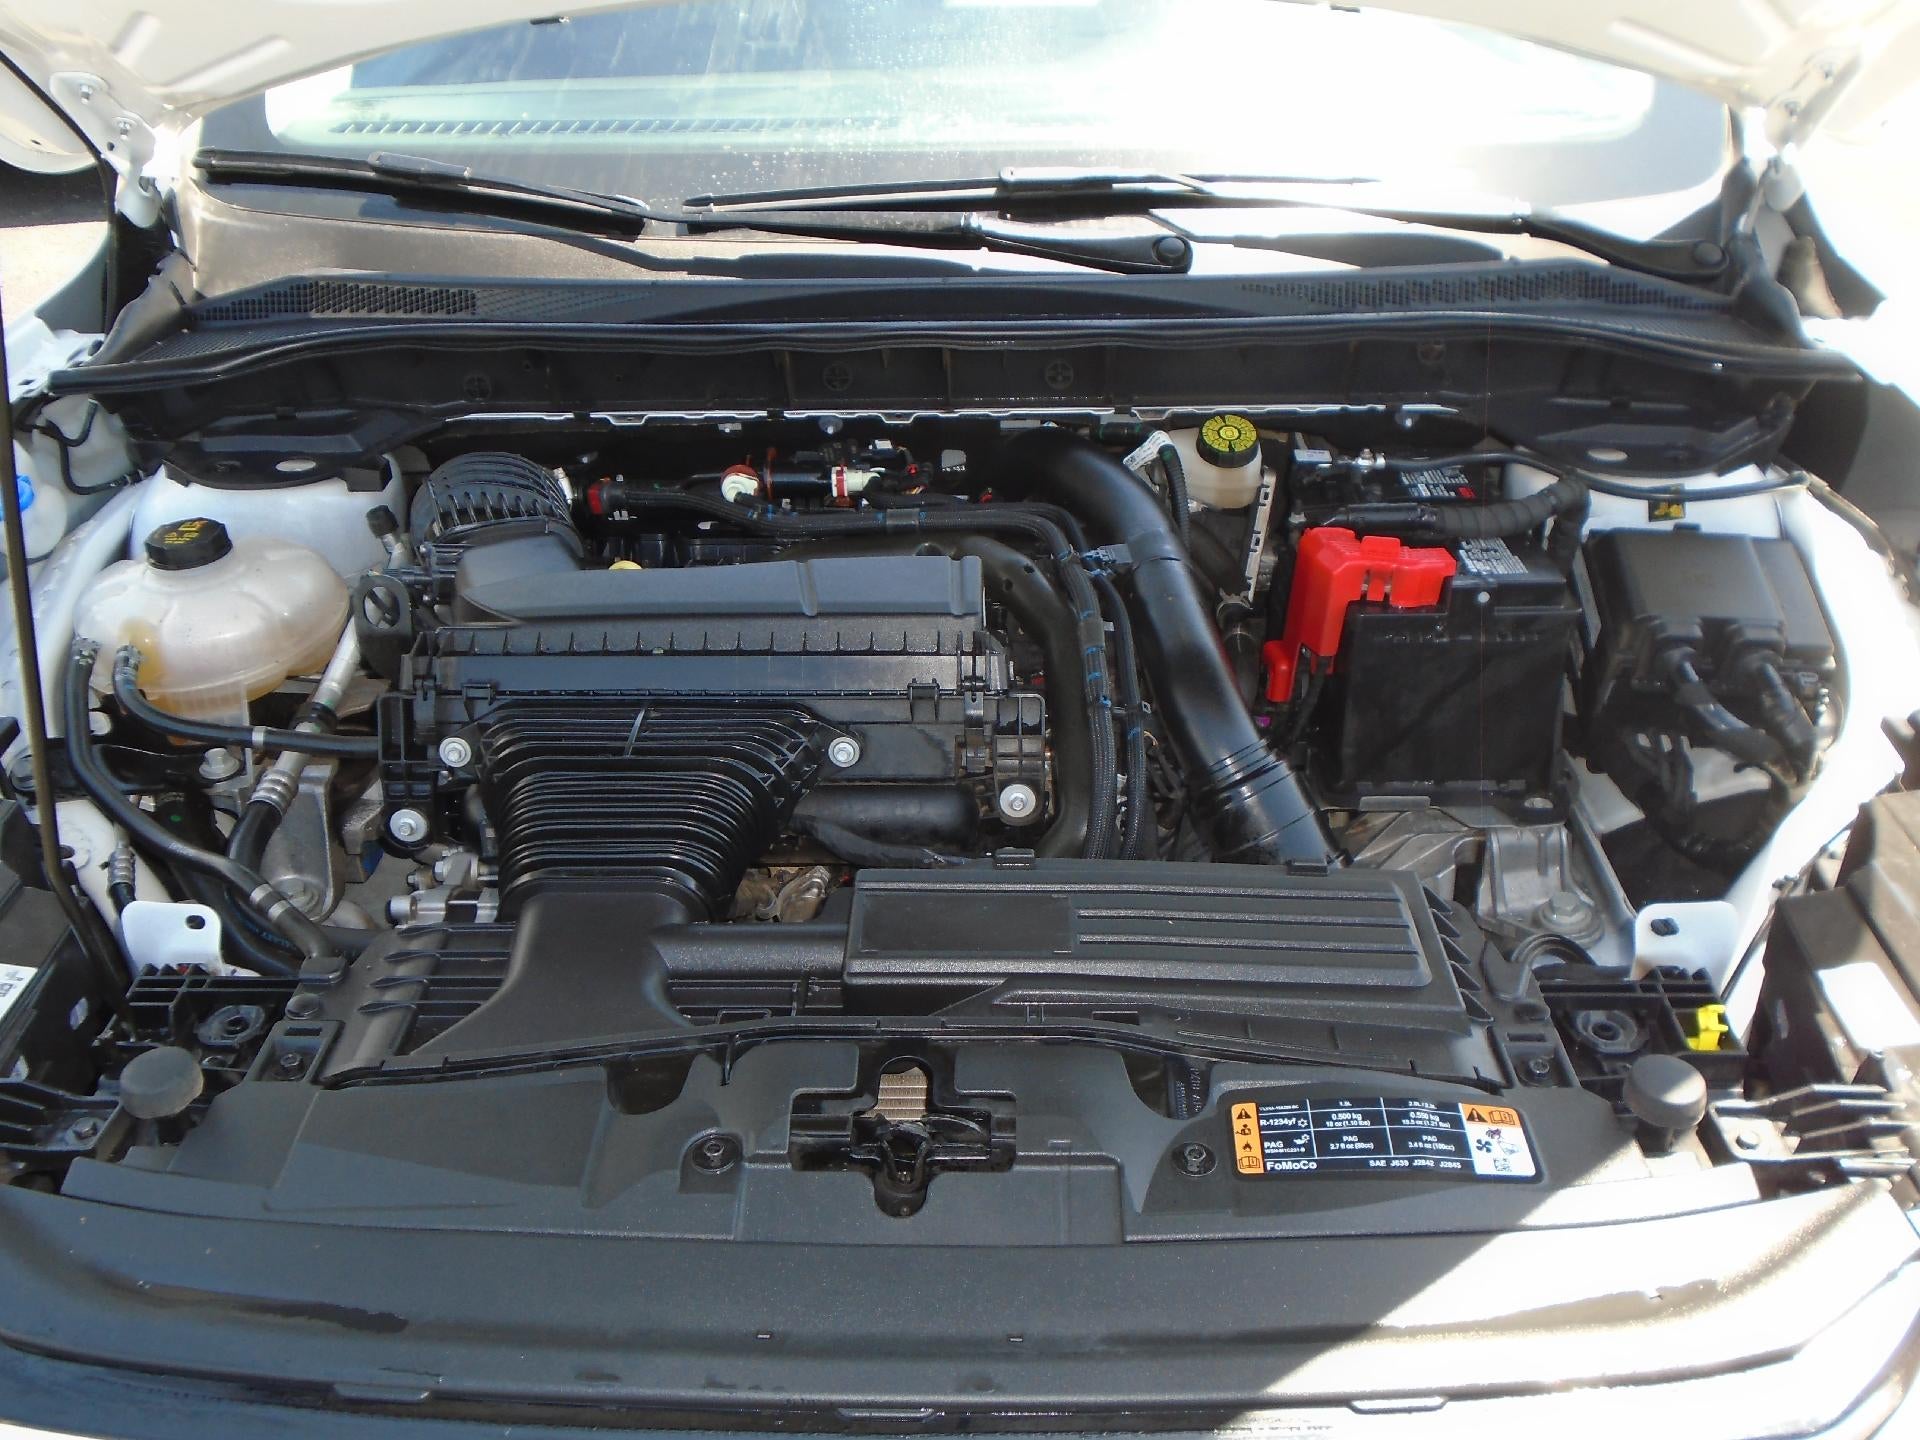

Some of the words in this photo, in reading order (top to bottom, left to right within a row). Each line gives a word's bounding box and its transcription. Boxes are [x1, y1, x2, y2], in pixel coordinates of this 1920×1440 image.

[1332, 1112, 1351, 1121] 0.500
[1352, 1112, 1363, 1121] kg
[1429, 1113, 1440, 1122] kg
[1260, 1117, 1297, 1126] R-1234yf
[1264, 1140, 1284, 1149] PAG
[1329, 1142, 1339, 1150] 2.7
[1266, 1160, 1317, 1171] FoMoCo
[1368, 1159, 1387, 1167] SAE
